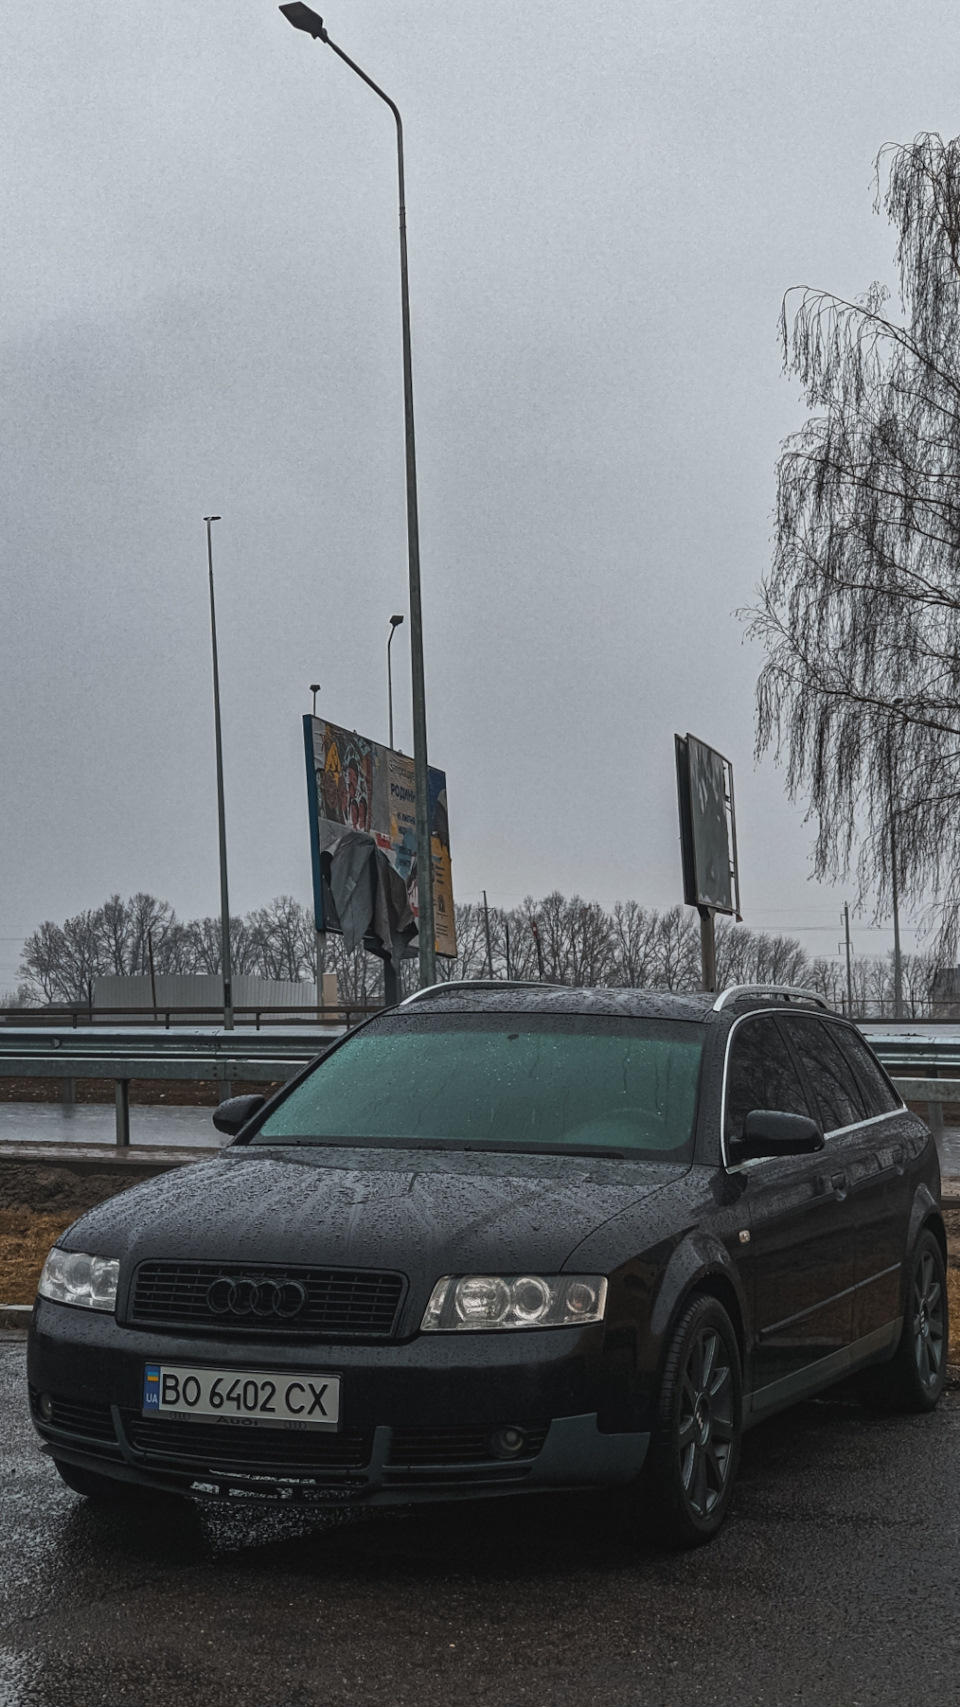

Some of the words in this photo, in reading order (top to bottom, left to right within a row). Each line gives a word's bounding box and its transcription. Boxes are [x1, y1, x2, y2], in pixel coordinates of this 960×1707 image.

[146, 1393, 158, 1403] UA
[161, 1373, 201, 1407] BO
[209, 1377, 276, 1413] 6402
[284, 1382, 329, 1416] CX
[216, 1416, 258, 1427] Audi
